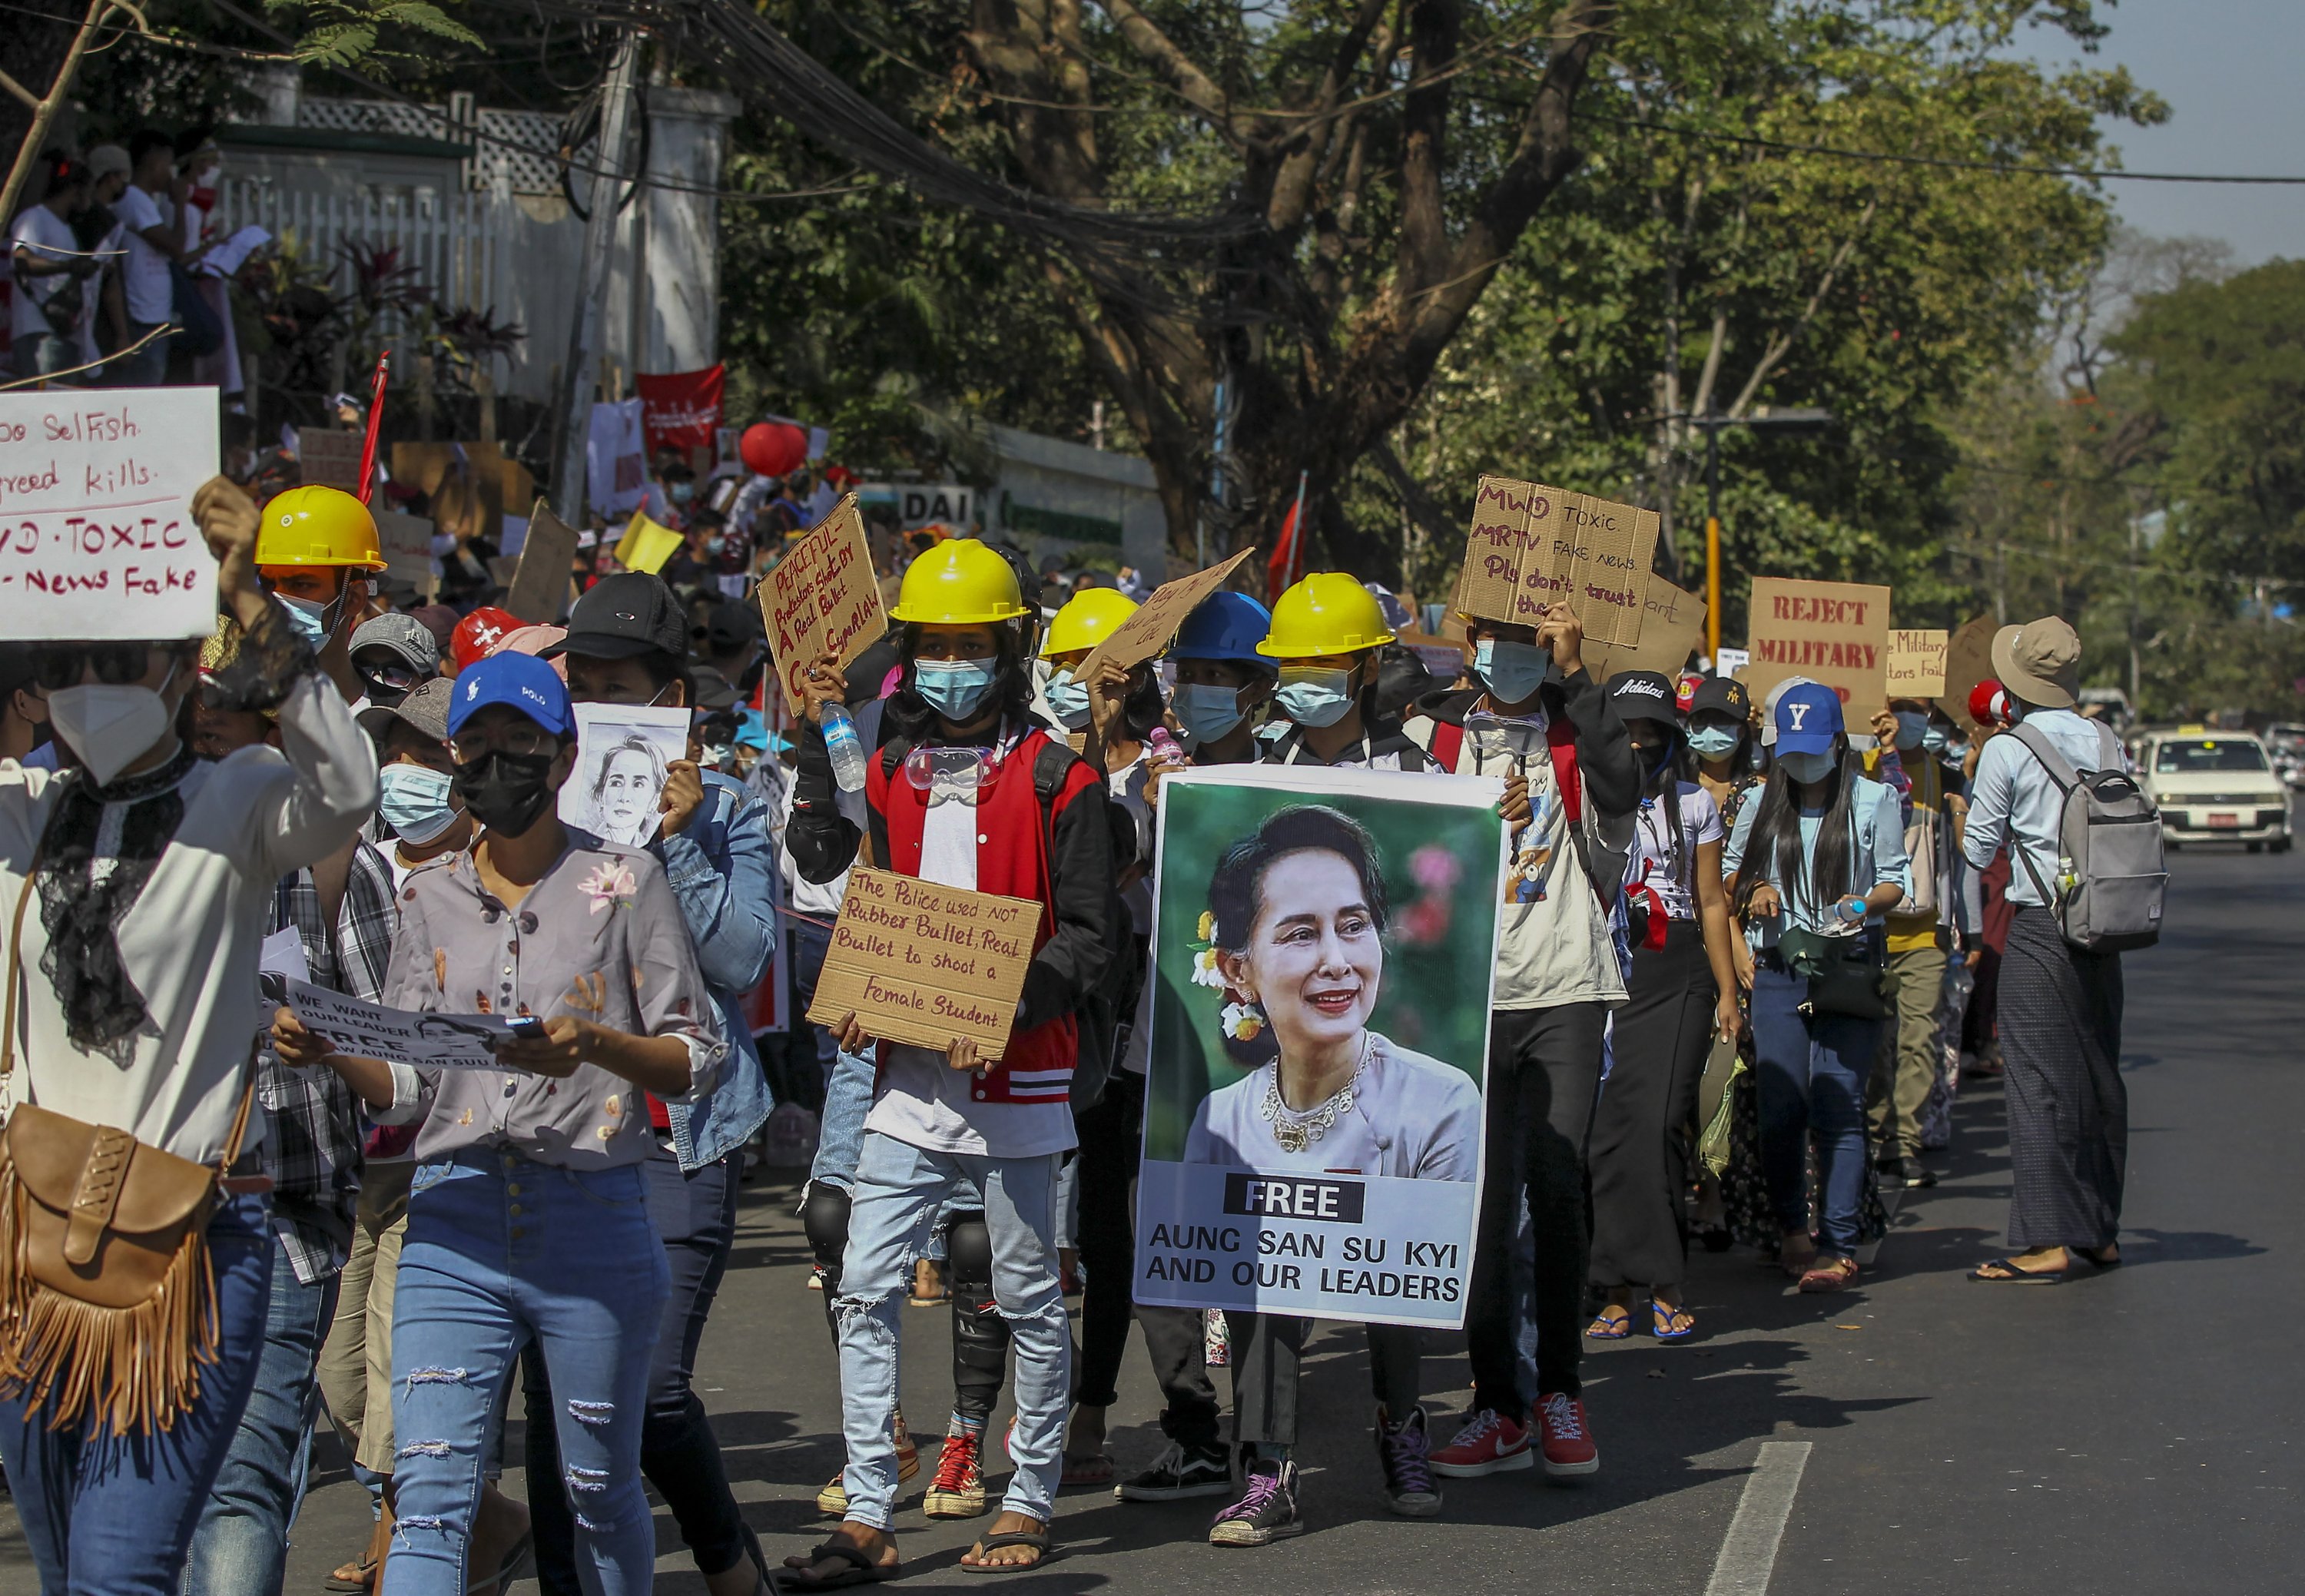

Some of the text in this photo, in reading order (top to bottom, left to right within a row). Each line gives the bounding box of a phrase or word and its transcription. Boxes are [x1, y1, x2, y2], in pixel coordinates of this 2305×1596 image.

[0, 460, 59, 501] reed
[1478, 484, 1550, 519] MWD
[1471, 523, 1541, 551] MRTV
[1553, 540, 1590, 560] FAKE
[25, 566, 197, 597] News Fake
[815, 554, 841, 592] Shot
[838, 542, 854, 569] BY
[1484, 555, 1637, 608] Pls don't trust
[1645, 591, 1679, 624] ant
[1773, 596, 1869, 625] REJECT
[779, 629, 794, 659] A
[1756, 639, 1880, 669] MILITARY
[1897, 631, 1948, 661] Military
[522, 686, 546, 706] POLO
[1613, 678, 1665, 700] Adidas
[1789, 703, 1811, 731] Y
[846, 897, 910, 930] Rubber
[854, 873, 1019, 922] The Police used NOT
[836, 927, 997, 980] Bullet to shoot a
[295, 992, 382, 1021] WE WANT
[862, 974, 925, 1010] Female
[301, 1010, 411, 1040] OUR LEADER
[361, 1049, 408, 1062] AUNG
[413, 1057, 449, 1066] SAN
[453, 1058, 489, 1067] SUU
[1244, 1180, 1340, 1219] FREE
[1149, 1223, 1458, 1269] AUNG SAN SU KYI
[1146, 1256, 1460, 1303] AND OUR LEADERS
